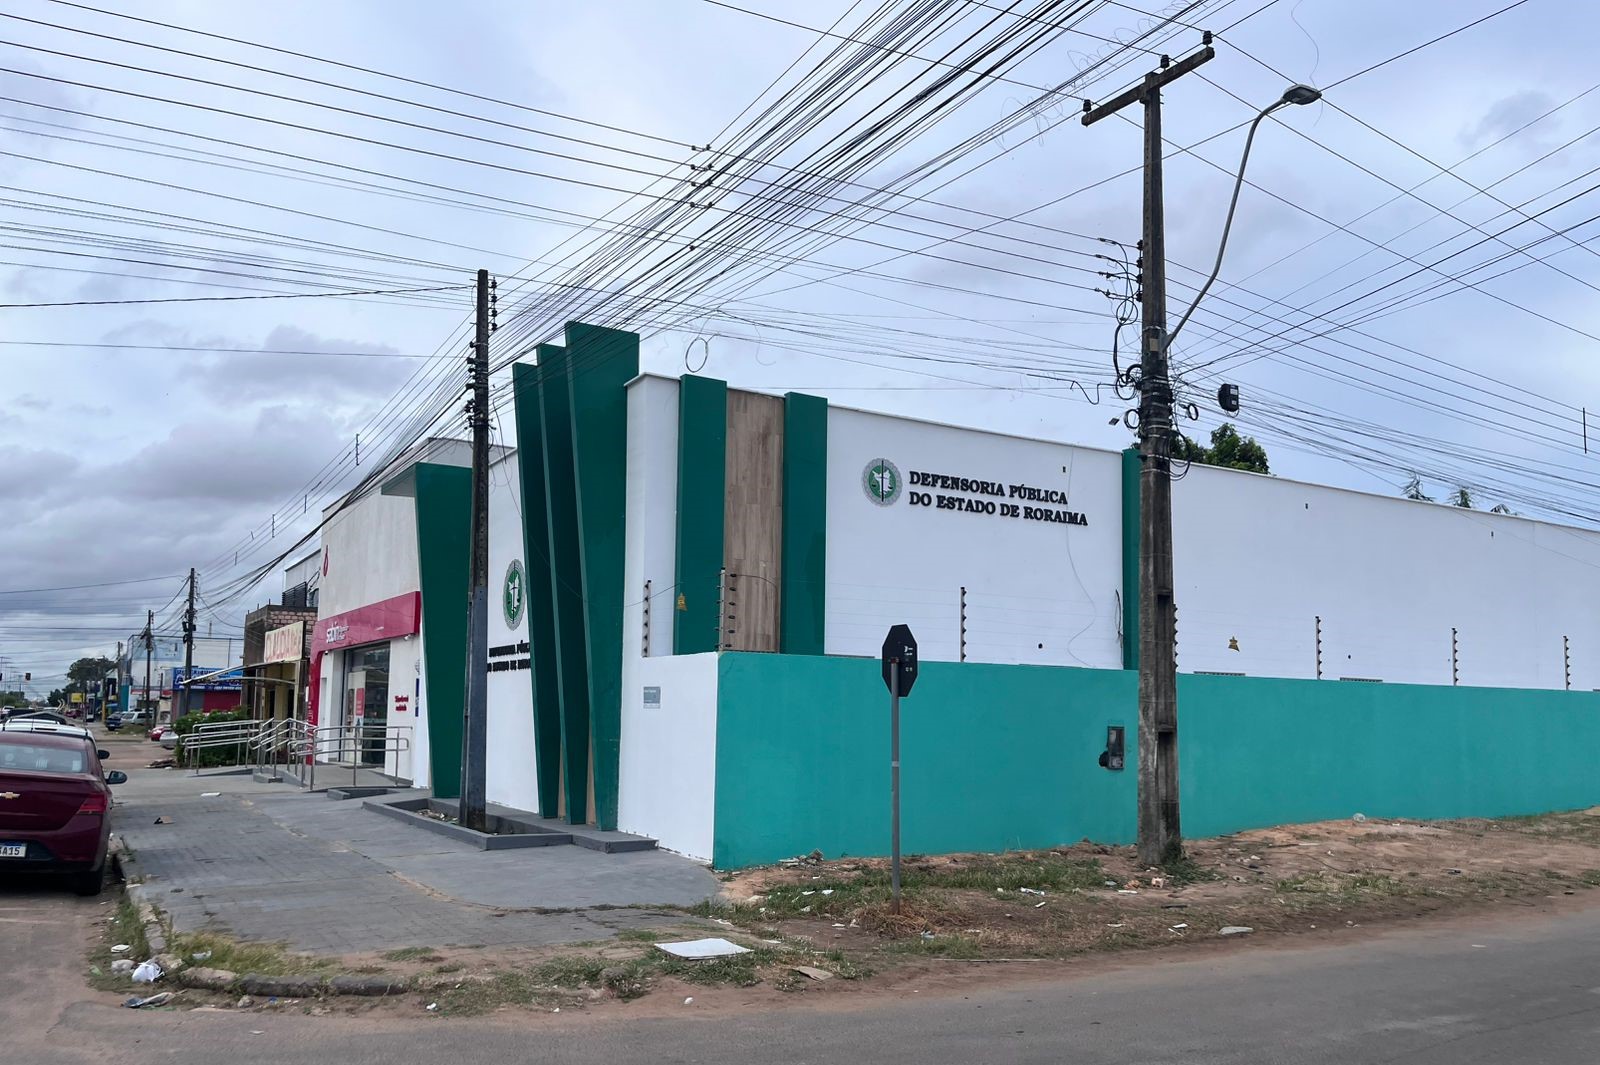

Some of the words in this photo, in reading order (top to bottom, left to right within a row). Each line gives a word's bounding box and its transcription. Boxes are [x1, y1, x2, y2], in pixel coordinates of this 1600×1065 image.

[909, 471, 1005, 497] DEFENSORIA
[1009, 484, 1068, 505] PÚBLICA
[909, 491, 932, 507] DO
[936, 495, 996, 515] ESTADO
[1000, 503, 1020, 518] DE
[1023, 506, 1088, 526] RORAIMA
[0, 846, 20, 856] A15
